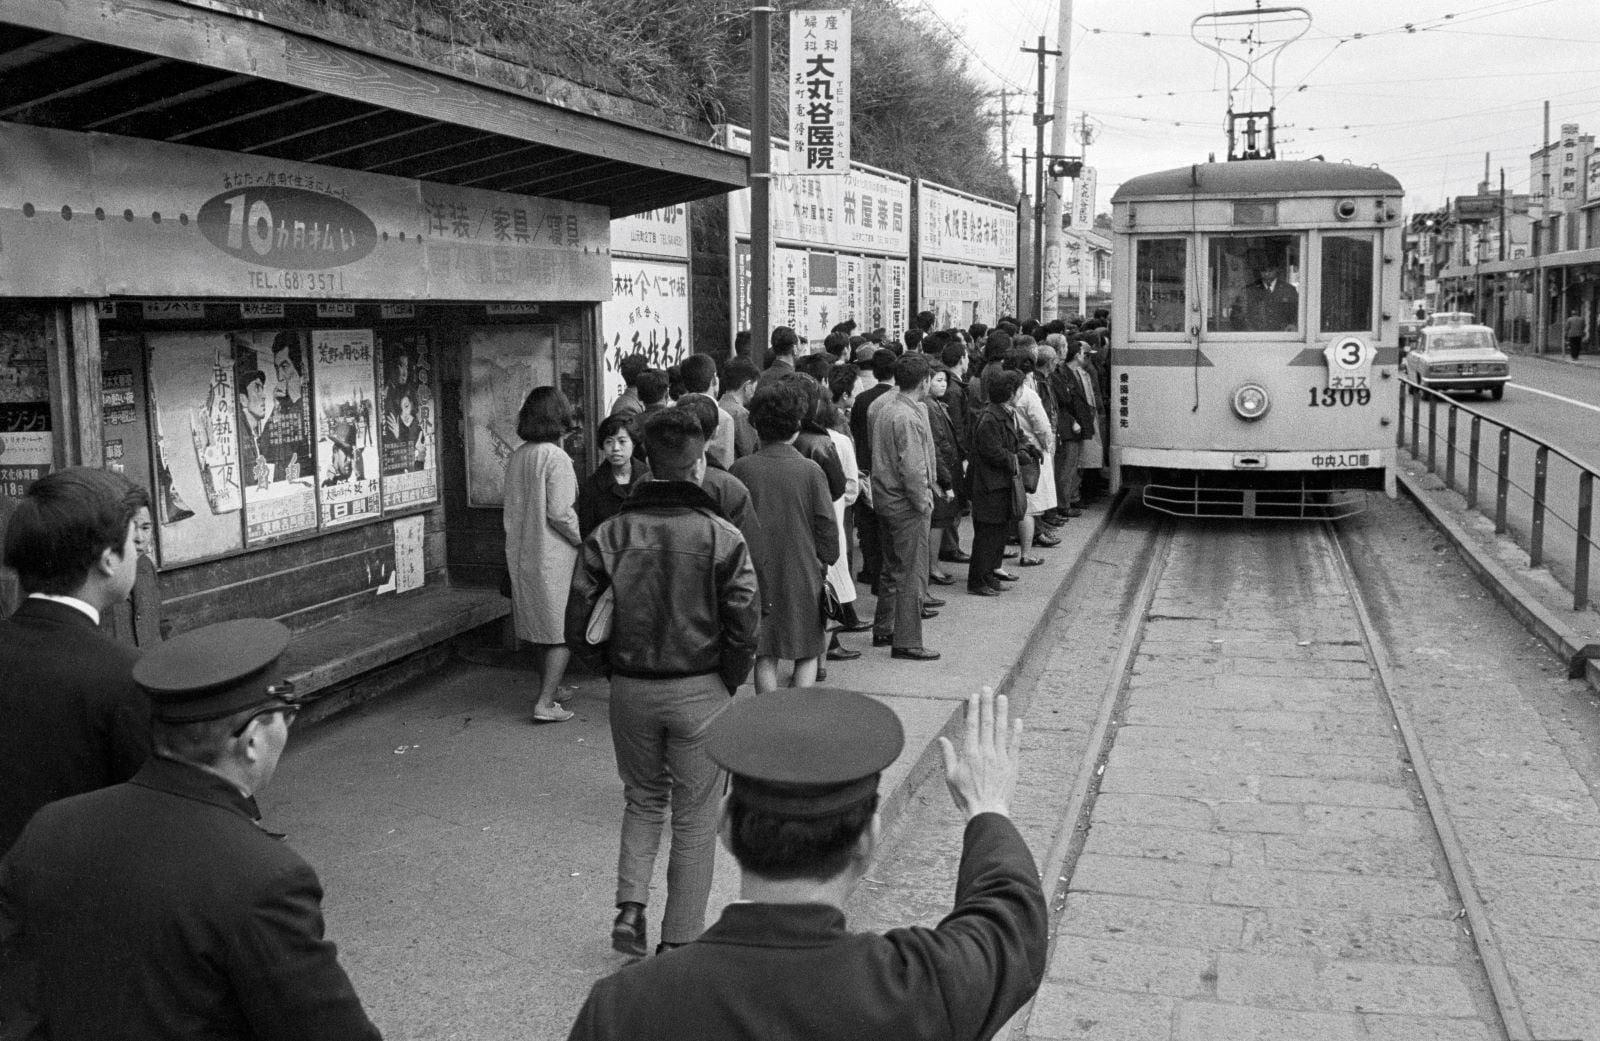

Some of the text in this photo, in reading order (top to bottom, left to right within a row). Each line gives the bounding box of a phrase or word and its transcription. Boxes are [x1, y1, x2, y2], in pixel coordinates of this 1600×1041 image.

[804, 15, 817, 52] 婦人科
[825, 15, 838, 52] 産科
[806, 54, 835, 170] 大丸谷医院
[611, 273, 634, 297] 木材
[629, 305, 660, 324] 有限会社
[318, 341, 372, 364] 荒野の用心棒
[1341, 342, 1361, 365] 3
[1331, 376, 1367, 389] ネコス
[1308, 387, 1371, 407] 1309
[208, 347, 239, 488] 界の熱い夜
[0, 482, 24, 496] 18日
